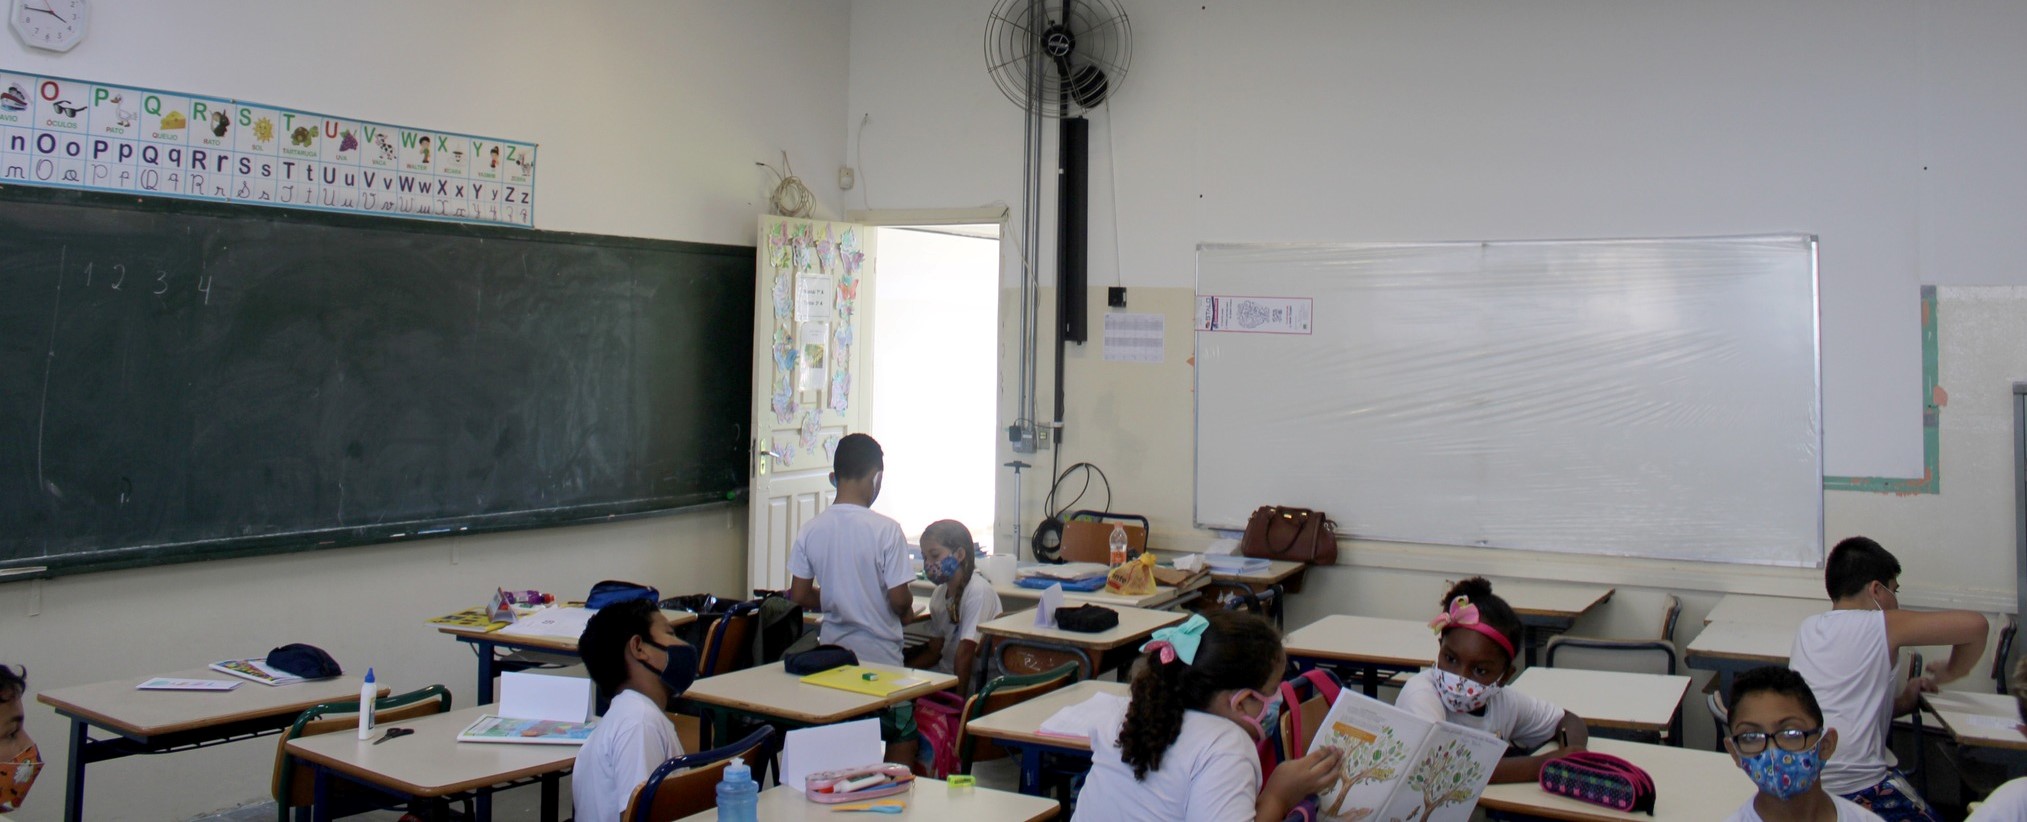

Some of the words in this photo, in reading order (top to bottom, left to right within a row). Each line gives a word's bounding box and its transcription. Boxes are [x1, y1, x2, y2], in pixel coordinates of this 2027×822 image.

[0, 114, 18, 122] AVIO
[106, 126, 124, 134] PATO
[152, 132, 178, 140] QUEIJO
[204, 138, 220, 146] RATO
[283, 148, 317, 157] TARTARUGA
[41, 81, 58, 101] O
[94, 88, 108, 106] P
[144, 96, 161, 116] Q
[193, 102, 207, 121] R
[240, 108, 251, 126] S
[283, 114, 295, 131] T
[326, 120, 338, 138] U
[364, 126, 376, 143] V
[402, 132, 417, 149] W
[438, 136, 448, 152] X
[474, 142, 482, 157] Y
[506, 146, 516, 161] Z
[12, 135, 24, 150] n
[37, 133, 56, 154] O
[66, 142, 80, 156] o
[94, 140, 108, 159] P
[119, 144, 132, 162] p
[142, 146, 158, 165] Q
[168, 148, 180, 167] q
[192, 150, 206, 170] R
[218, 155, 228, 172] r
[239, 157, 250, 174] S
[262, 164, 270, 177] s
[283, 162, 295, 179] T
[306, 164, 313, 181] t
[324, 166, 336, 184] U
[345, 174, 354, 186] u
[364, 171, 375, 188] V
[384, 178, 392, 190] v
[399, 176, 414, 192] W
[418, 182, 432, 194] w
[437, 179, 448, 196] X
[456, 185, 464, 198] x
[473, 184, 482, 199] Y
[492, 190, 498, 200] y
[505, 186, 515, 202] Z
[521, 192, 528, 204] z
[84, 262, 92, 286] 1
[112, 264, 125, 291] 2
[154, 270, 168, 294] 3
[198, 276, 212, 304] 4
